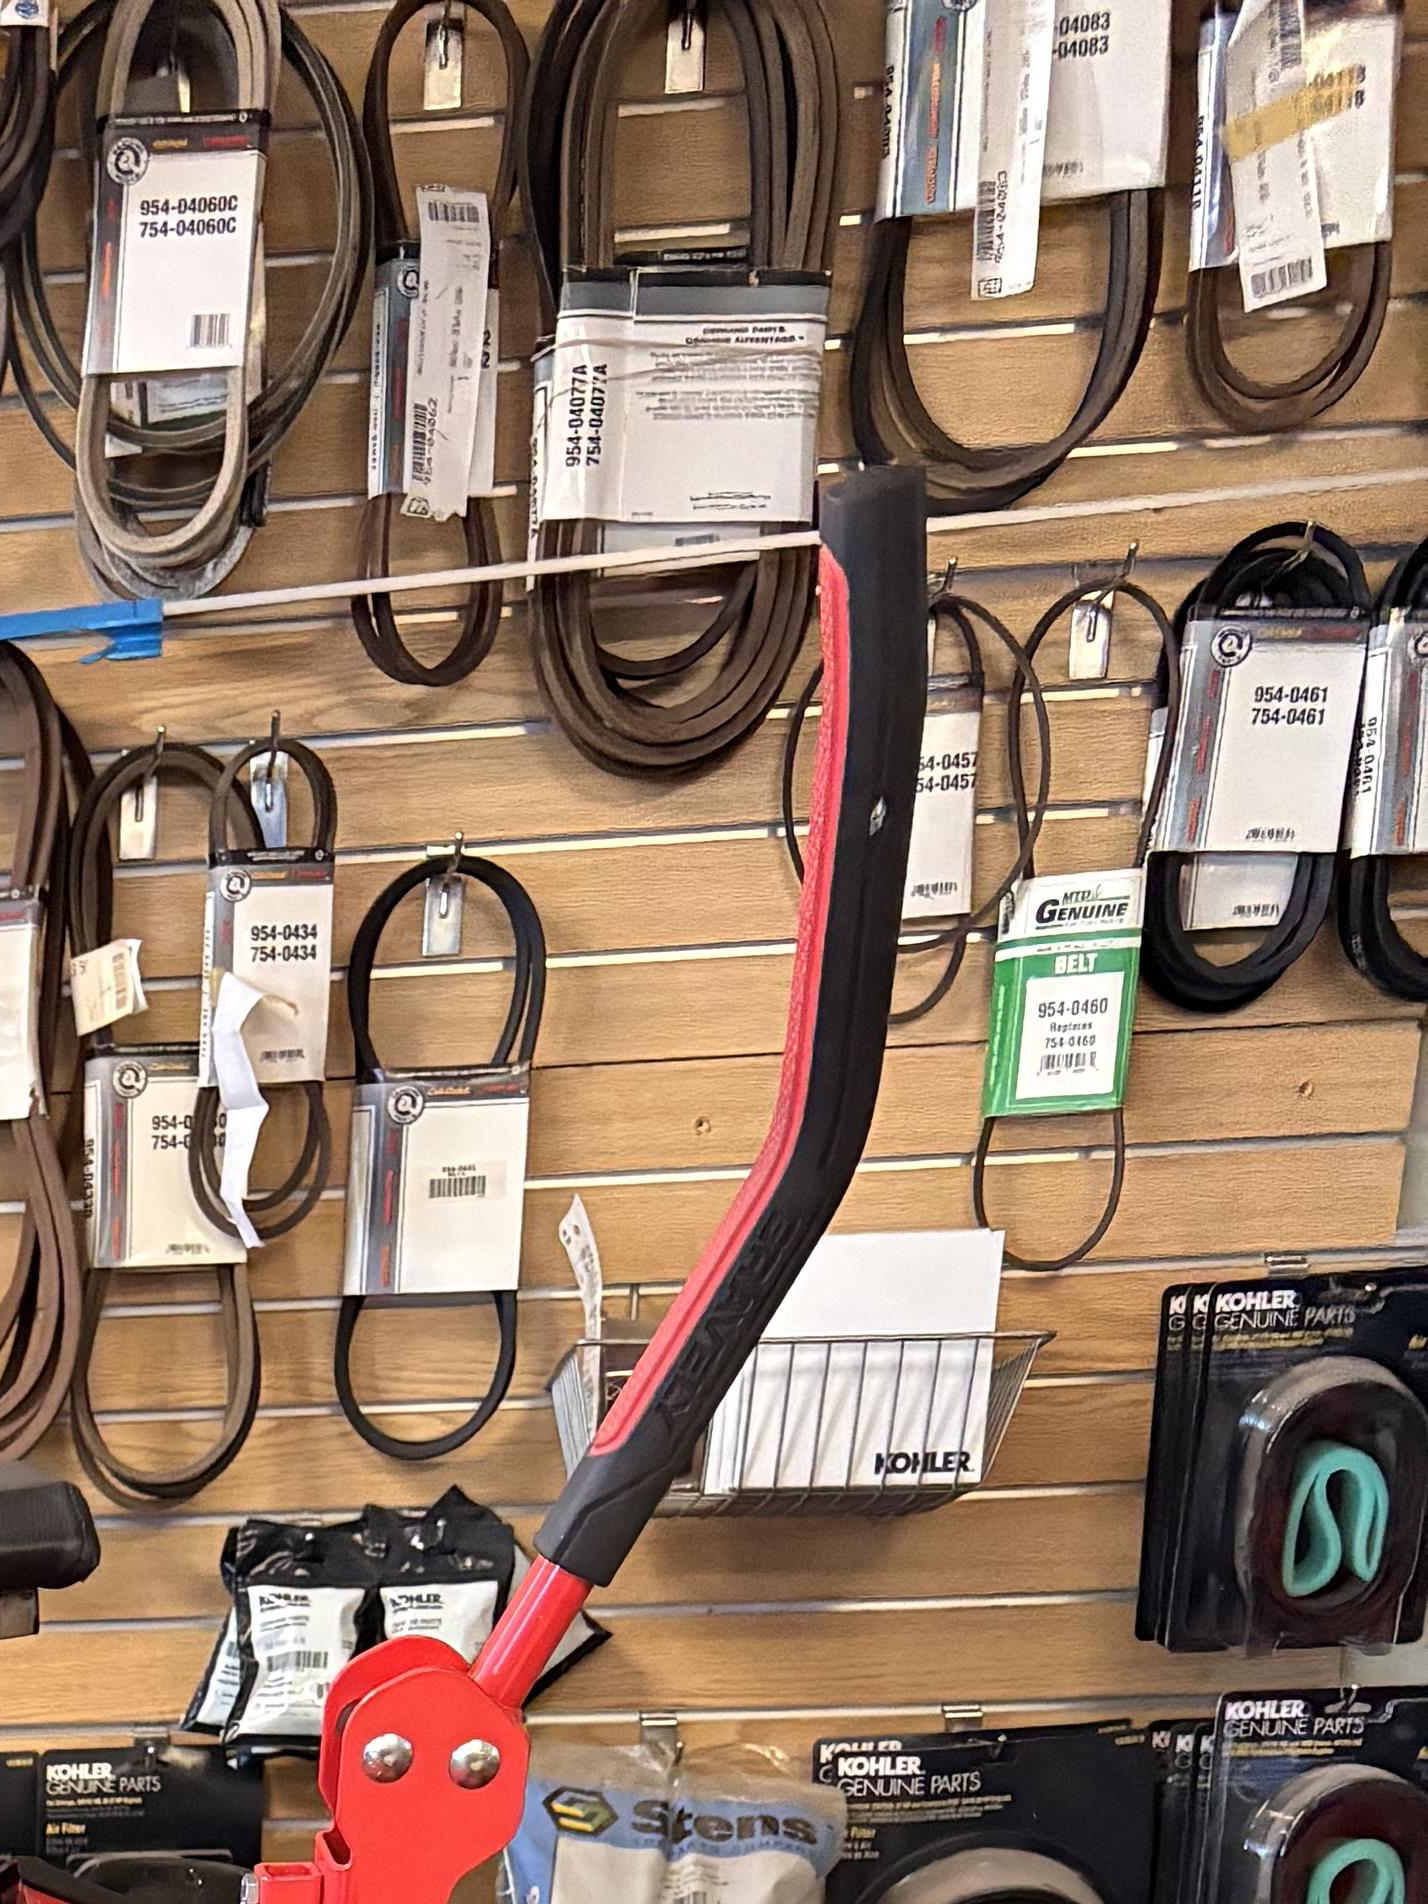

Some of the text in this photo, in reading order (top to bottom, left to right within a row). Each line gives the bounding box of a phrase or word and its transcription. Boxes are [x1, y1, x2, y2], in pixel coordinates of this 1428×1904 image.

[140, 195, 238, 216] 954-04060C
[139, 217, 237, 238] 754-04060C
[566, 364, 587, 467] 954-04077A
[1254, 686, 1329, 704] 954-0461
[1251, 708, 1325, 726] 754-0461
[917, 751, 977, 771] 54-0457
[915, 773, 976, 794] 54-0457
[1035, 898, 1129, 924] GENUINE
[250, 924, 318, 942] 954-0434
[250, 944, 317, 963] 754-0434
[1055, 953, 1098, 974] BELT
[1038, 998, 1108, 1018] 954-0460
[1215, 1289, 1297, 1312] KOHLER
[1214, 1308, 1298, 1331] GENUINE
[874, 1452, 974, 1474] KOHLER
[1225, 1699, 1306, 1720] KOHLER
[1223, 1717, 1365, 1738] GENUINE PARTS
[46, 1763, 114, 1781] KOHLER
[838, 1757, 924, 1775] KOHLER
[46, 1777, 161, 1795] GENUINE PARTS
[838, 1772, 982, 1797] GENUINE PARTS
[632, 1800, 818, 1845] Stens
